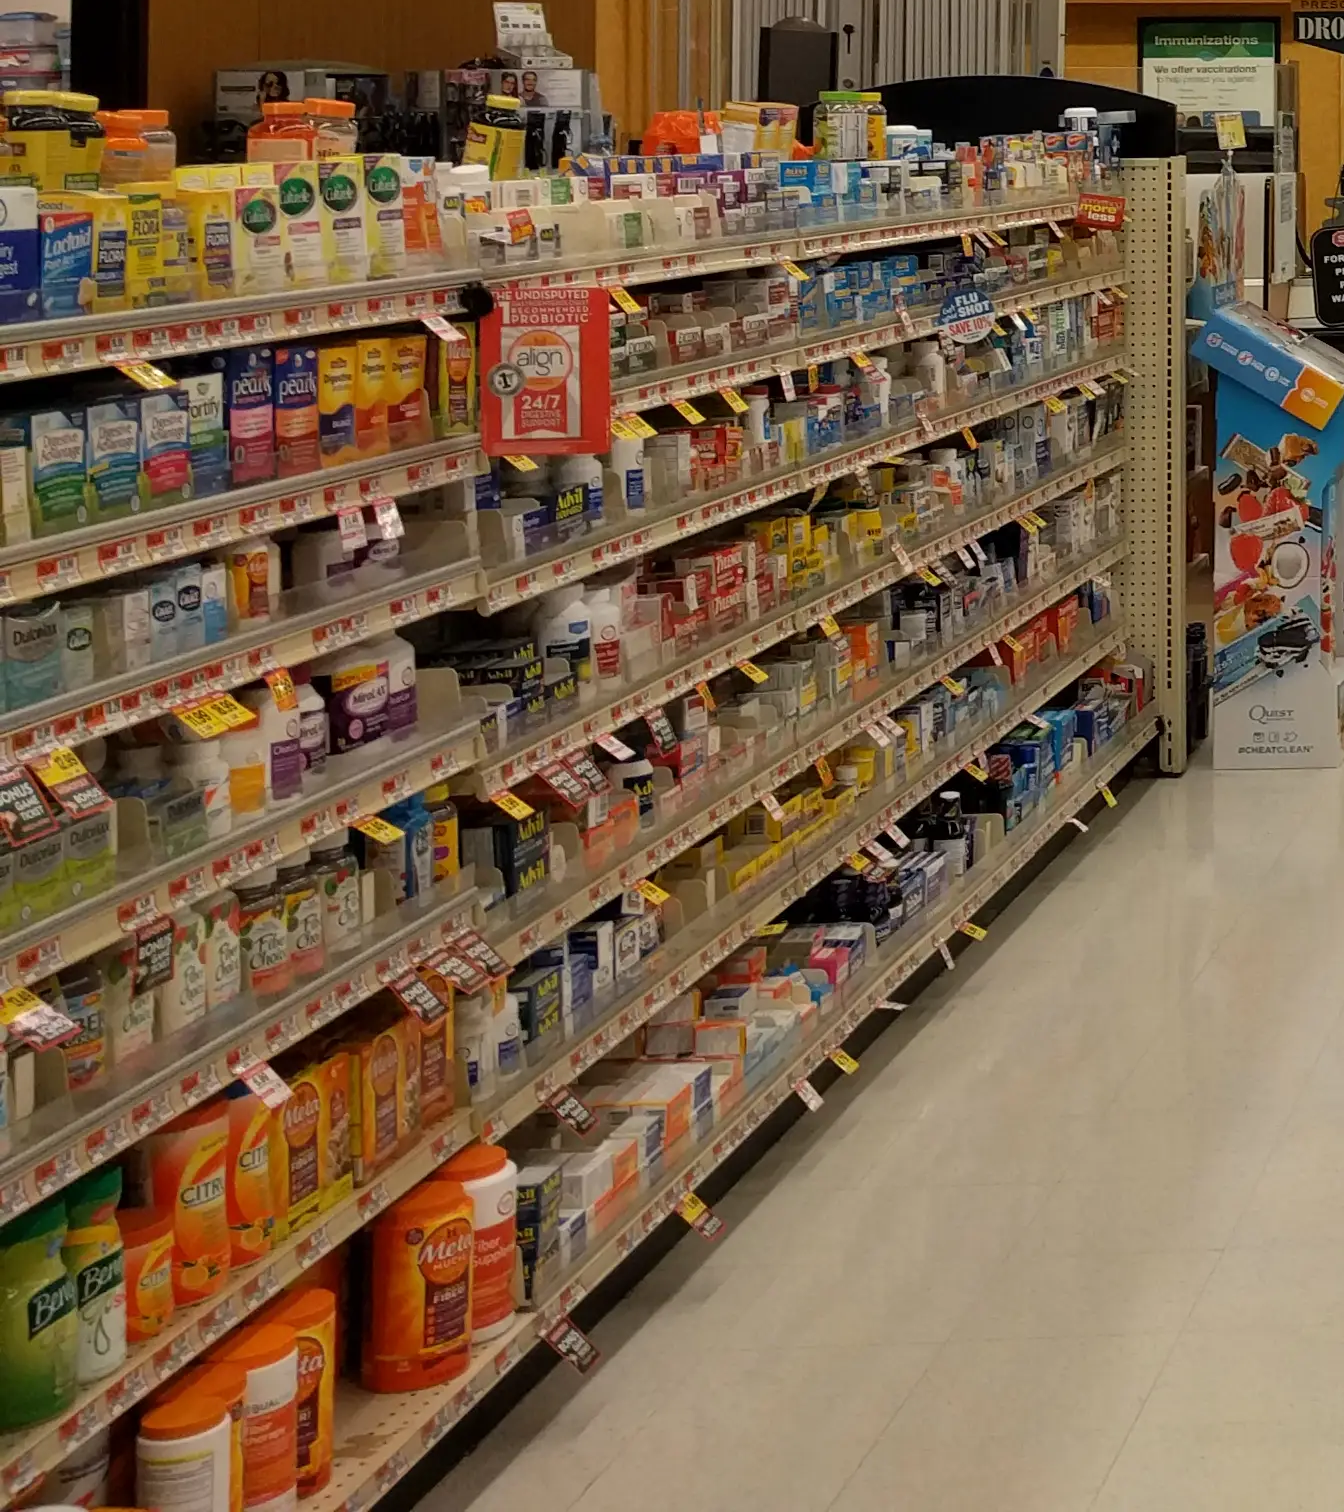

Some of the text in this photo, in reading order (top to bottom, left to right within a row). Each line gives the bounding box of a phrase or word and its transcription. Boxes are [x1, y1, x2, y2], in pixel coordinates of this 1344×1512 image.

[1154, 35, 1259, 46] Immunizations
[1080, 202, 1117, 214] more
[1088, 211, 1116, 222] less
[44, 226, 92, 259] Lactaid
[491, 289, 589, 301] THE UNDISPUTED
[955, 291, 979, 305] FLU
[511, 306, 589, 314] RECOMMENDED
[957, 300, 991, 319] SHOT
[511, 313, 589, 324] PROBIOTIC
[517, 348, 564, 376] align
[521, 394, 561, 410] 24/7
